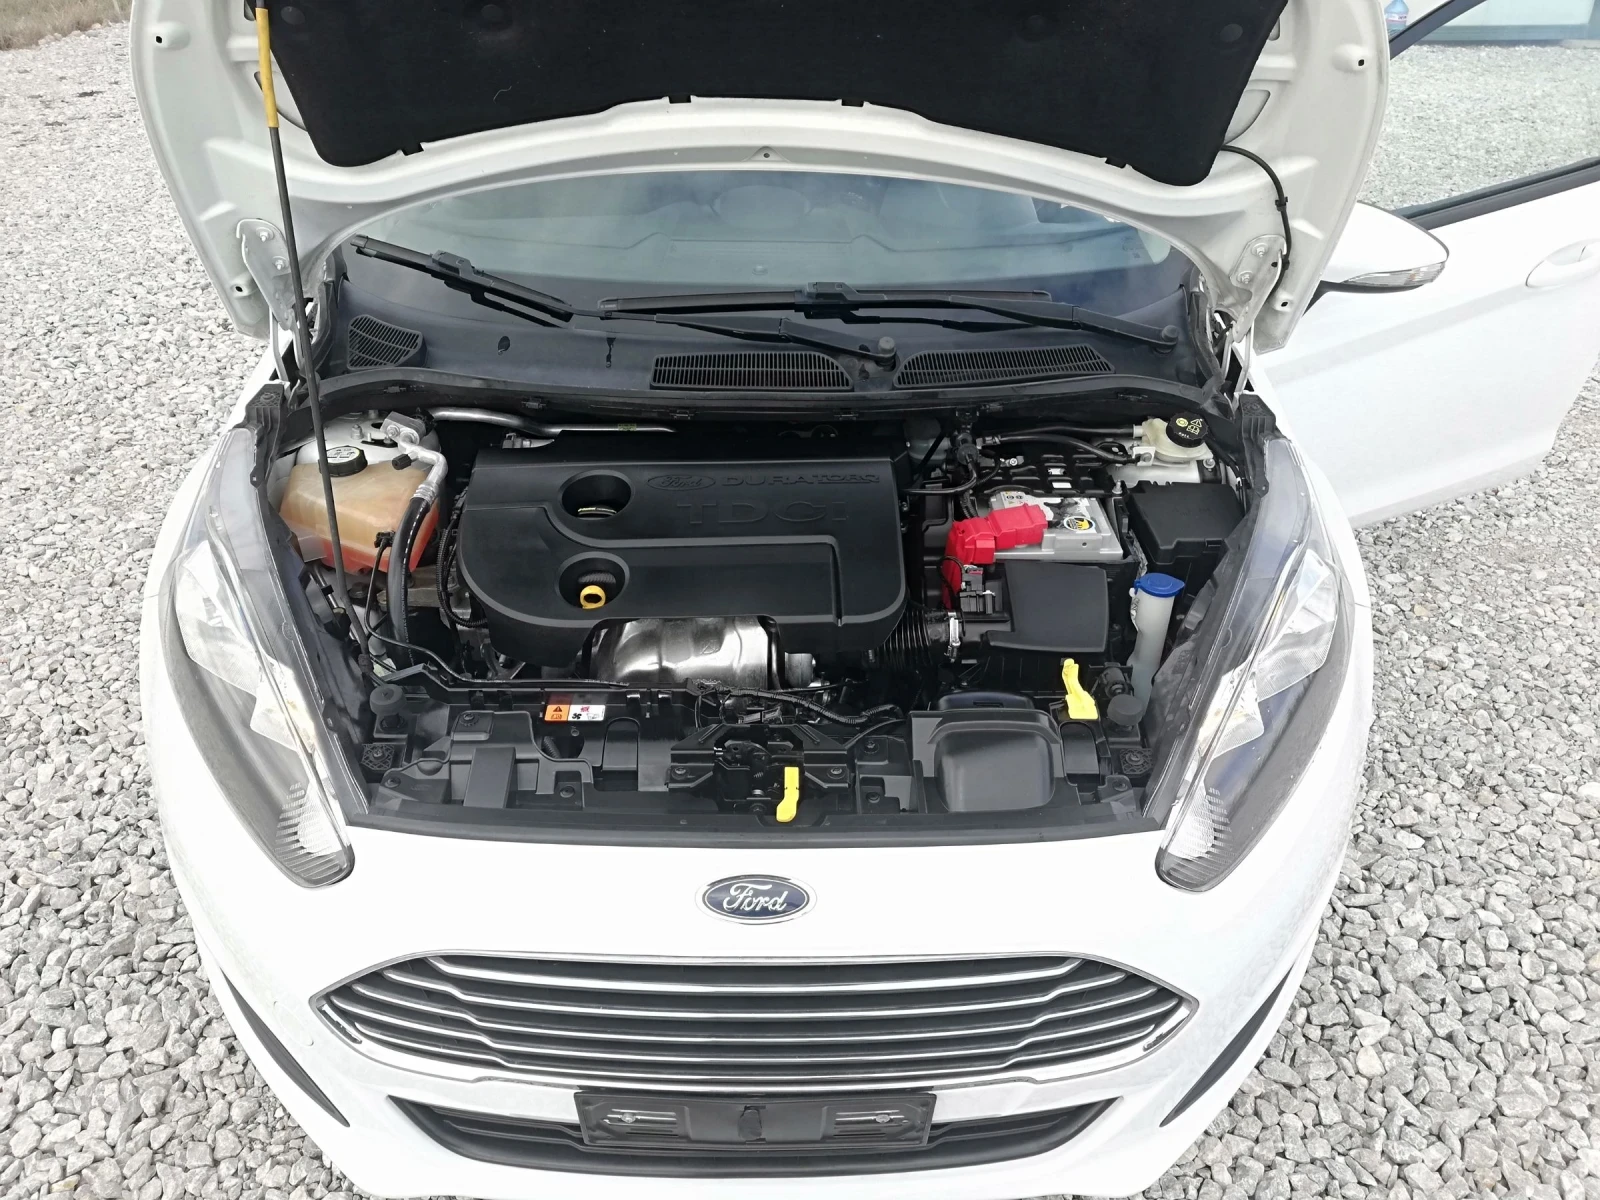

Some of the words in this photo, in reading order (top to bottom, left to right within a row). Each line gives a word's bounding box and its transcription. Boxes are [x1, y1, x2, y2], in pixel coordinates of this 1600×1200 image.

[660, 475, 703, 488] Ford
[722, 474, 881, 486] DURATORQ
[723, 883, 788, 911] Ford
